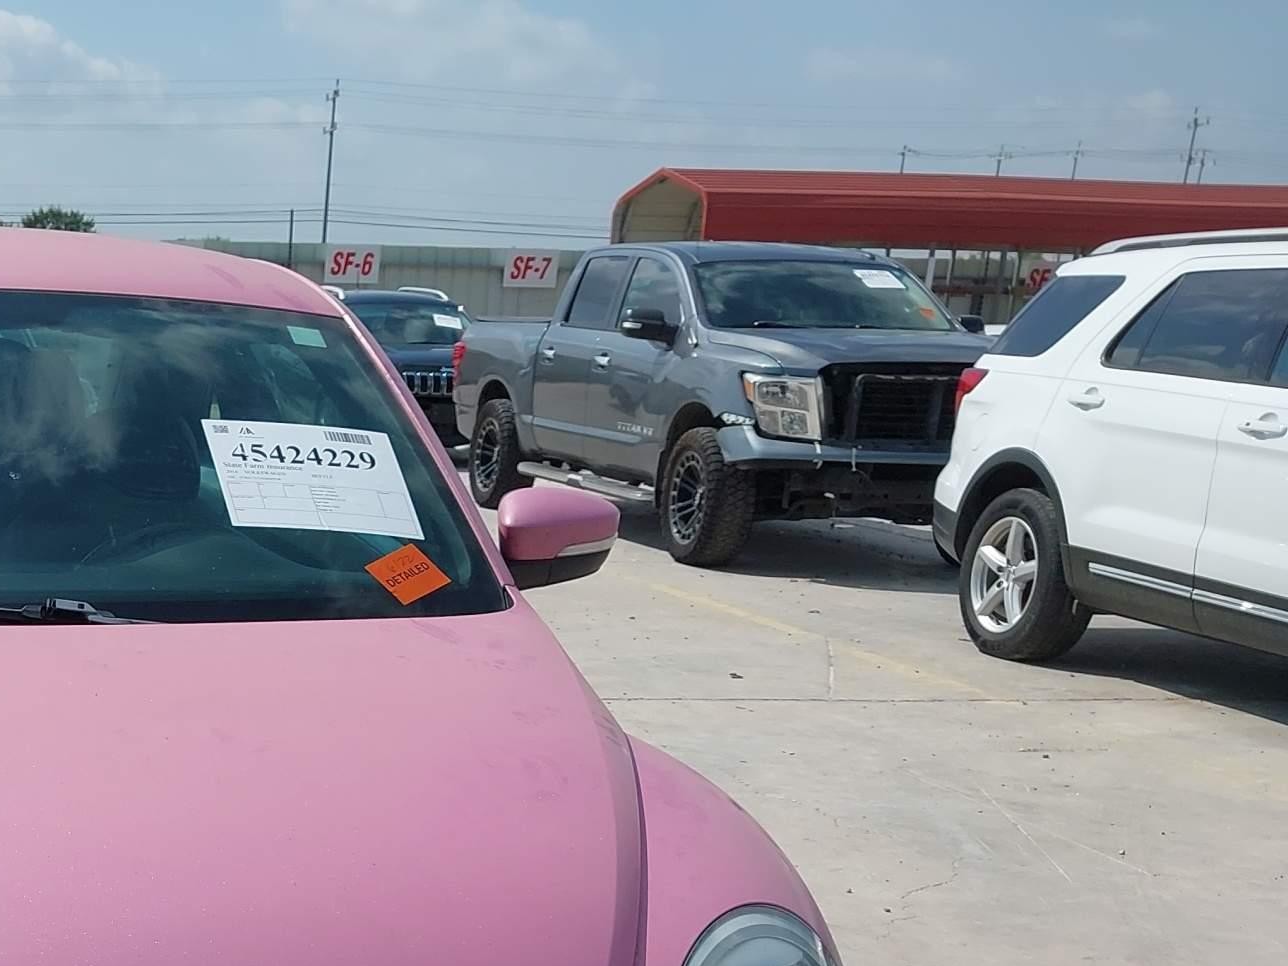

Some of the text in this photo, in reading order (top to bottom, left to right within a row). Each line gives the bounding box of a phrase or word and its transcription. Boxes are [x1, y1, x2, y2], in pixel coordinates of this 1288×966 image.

[330, 251, 375, 276] SF-6
[510, 255, 553, 280] SF-7
[231, 442, 377, 471] 45424229
[385, 561, 430, 588] DETAILED
